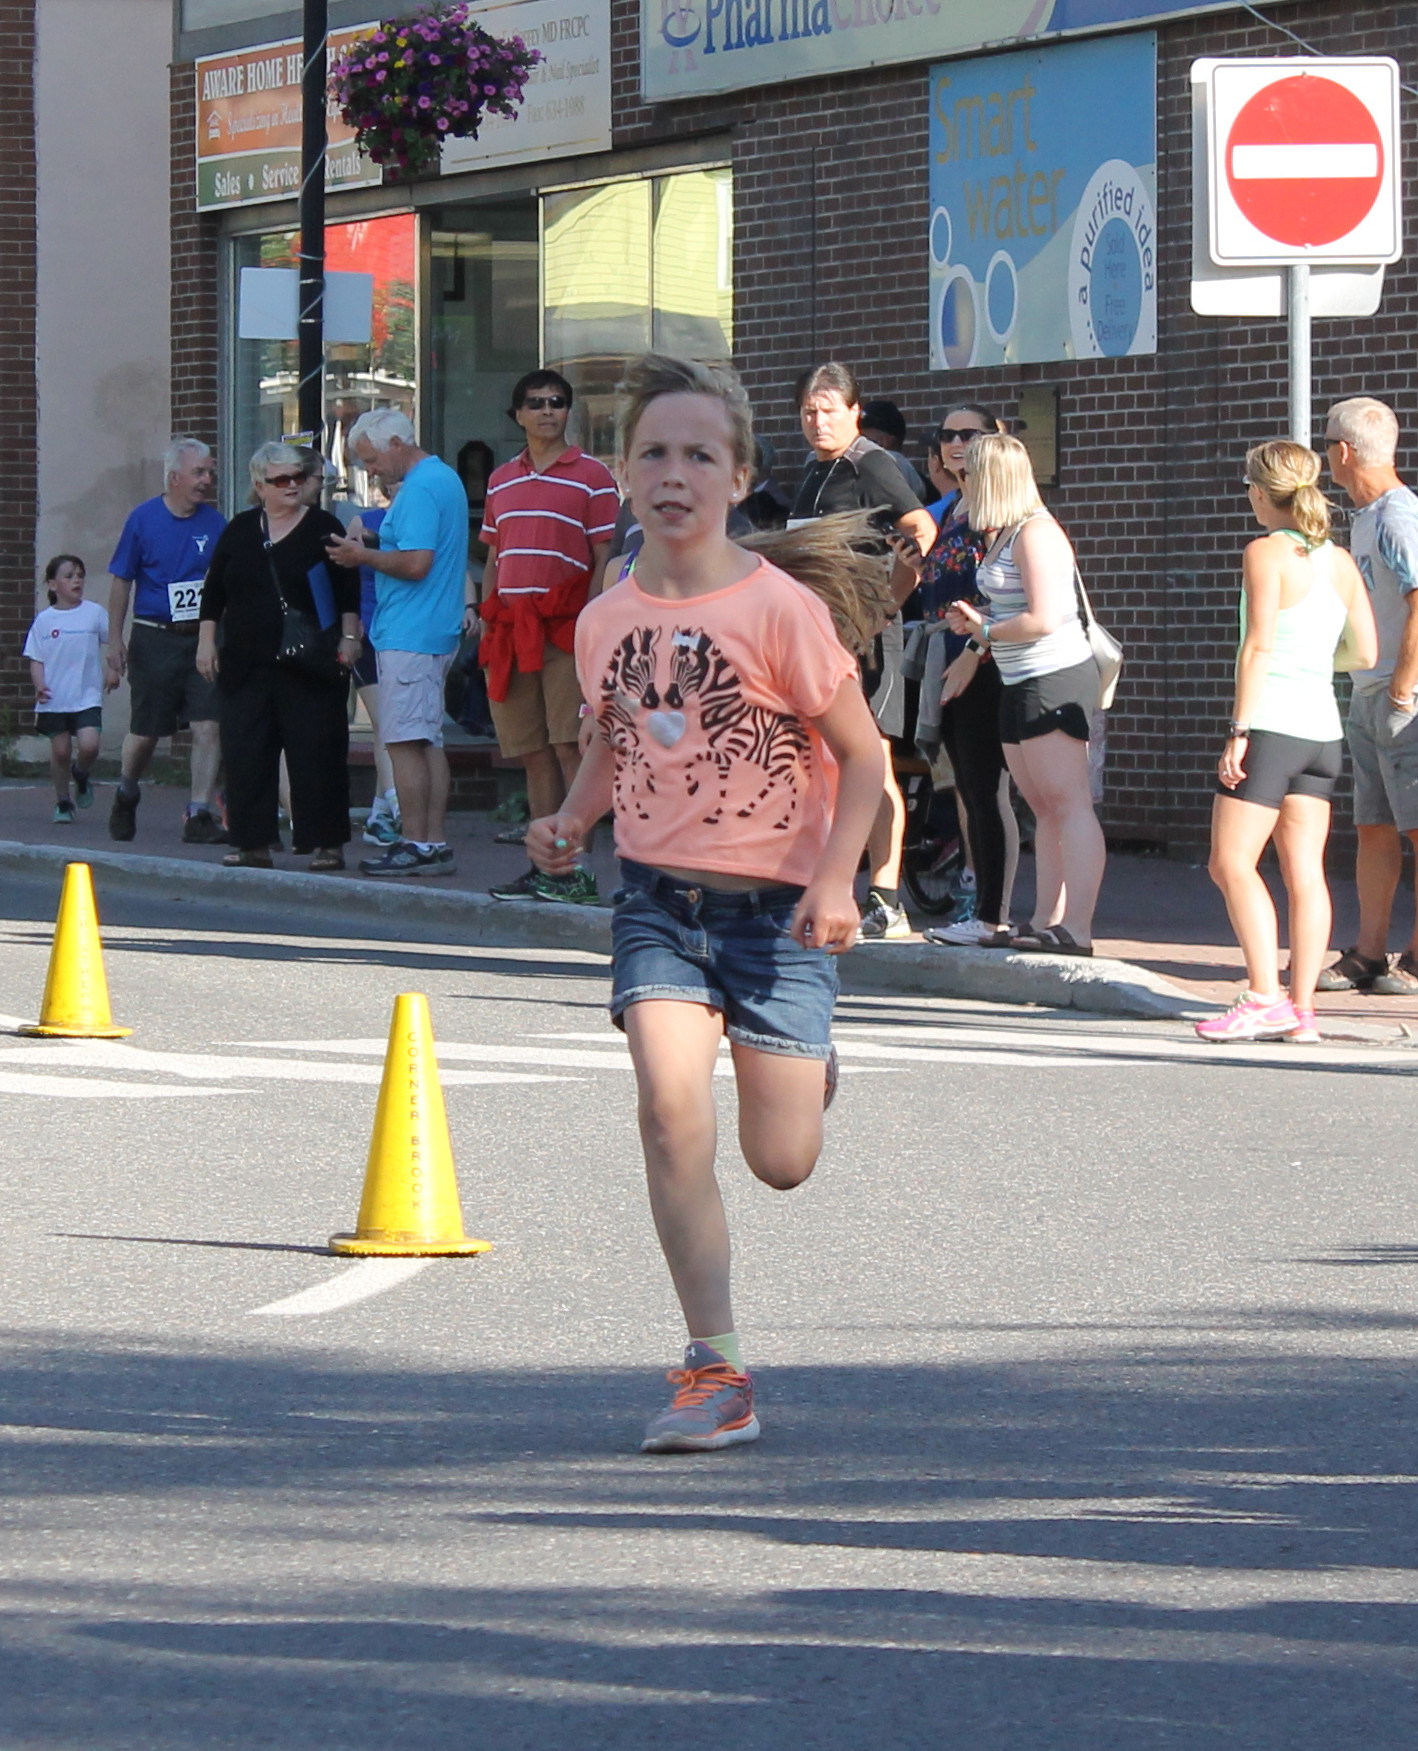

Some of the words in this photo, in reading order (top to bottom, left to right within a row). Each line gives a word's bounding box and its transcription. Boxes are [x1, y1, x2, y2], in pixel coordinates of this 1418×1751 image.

[703, 0, 941, 54] Pharma
[203, 65, 244, 100] AWARE
[247, 57, 284, 93] HOME
[935, 73, 1037, 164] Smart
[214, 170, 241, 198] Sales
[262, 162, 299, 190] Service
[325, 153, 361, 180] Rentals
[963, 160, 1066, 242] water
[1081, 180, 1135, 274] purified
[1134, 204, 1155, 292] idea
[174, 588, 204, 609] 22
[407, 1031, 420, 1121] CORNER
[411, 1135, 423, 1209] BROOK
